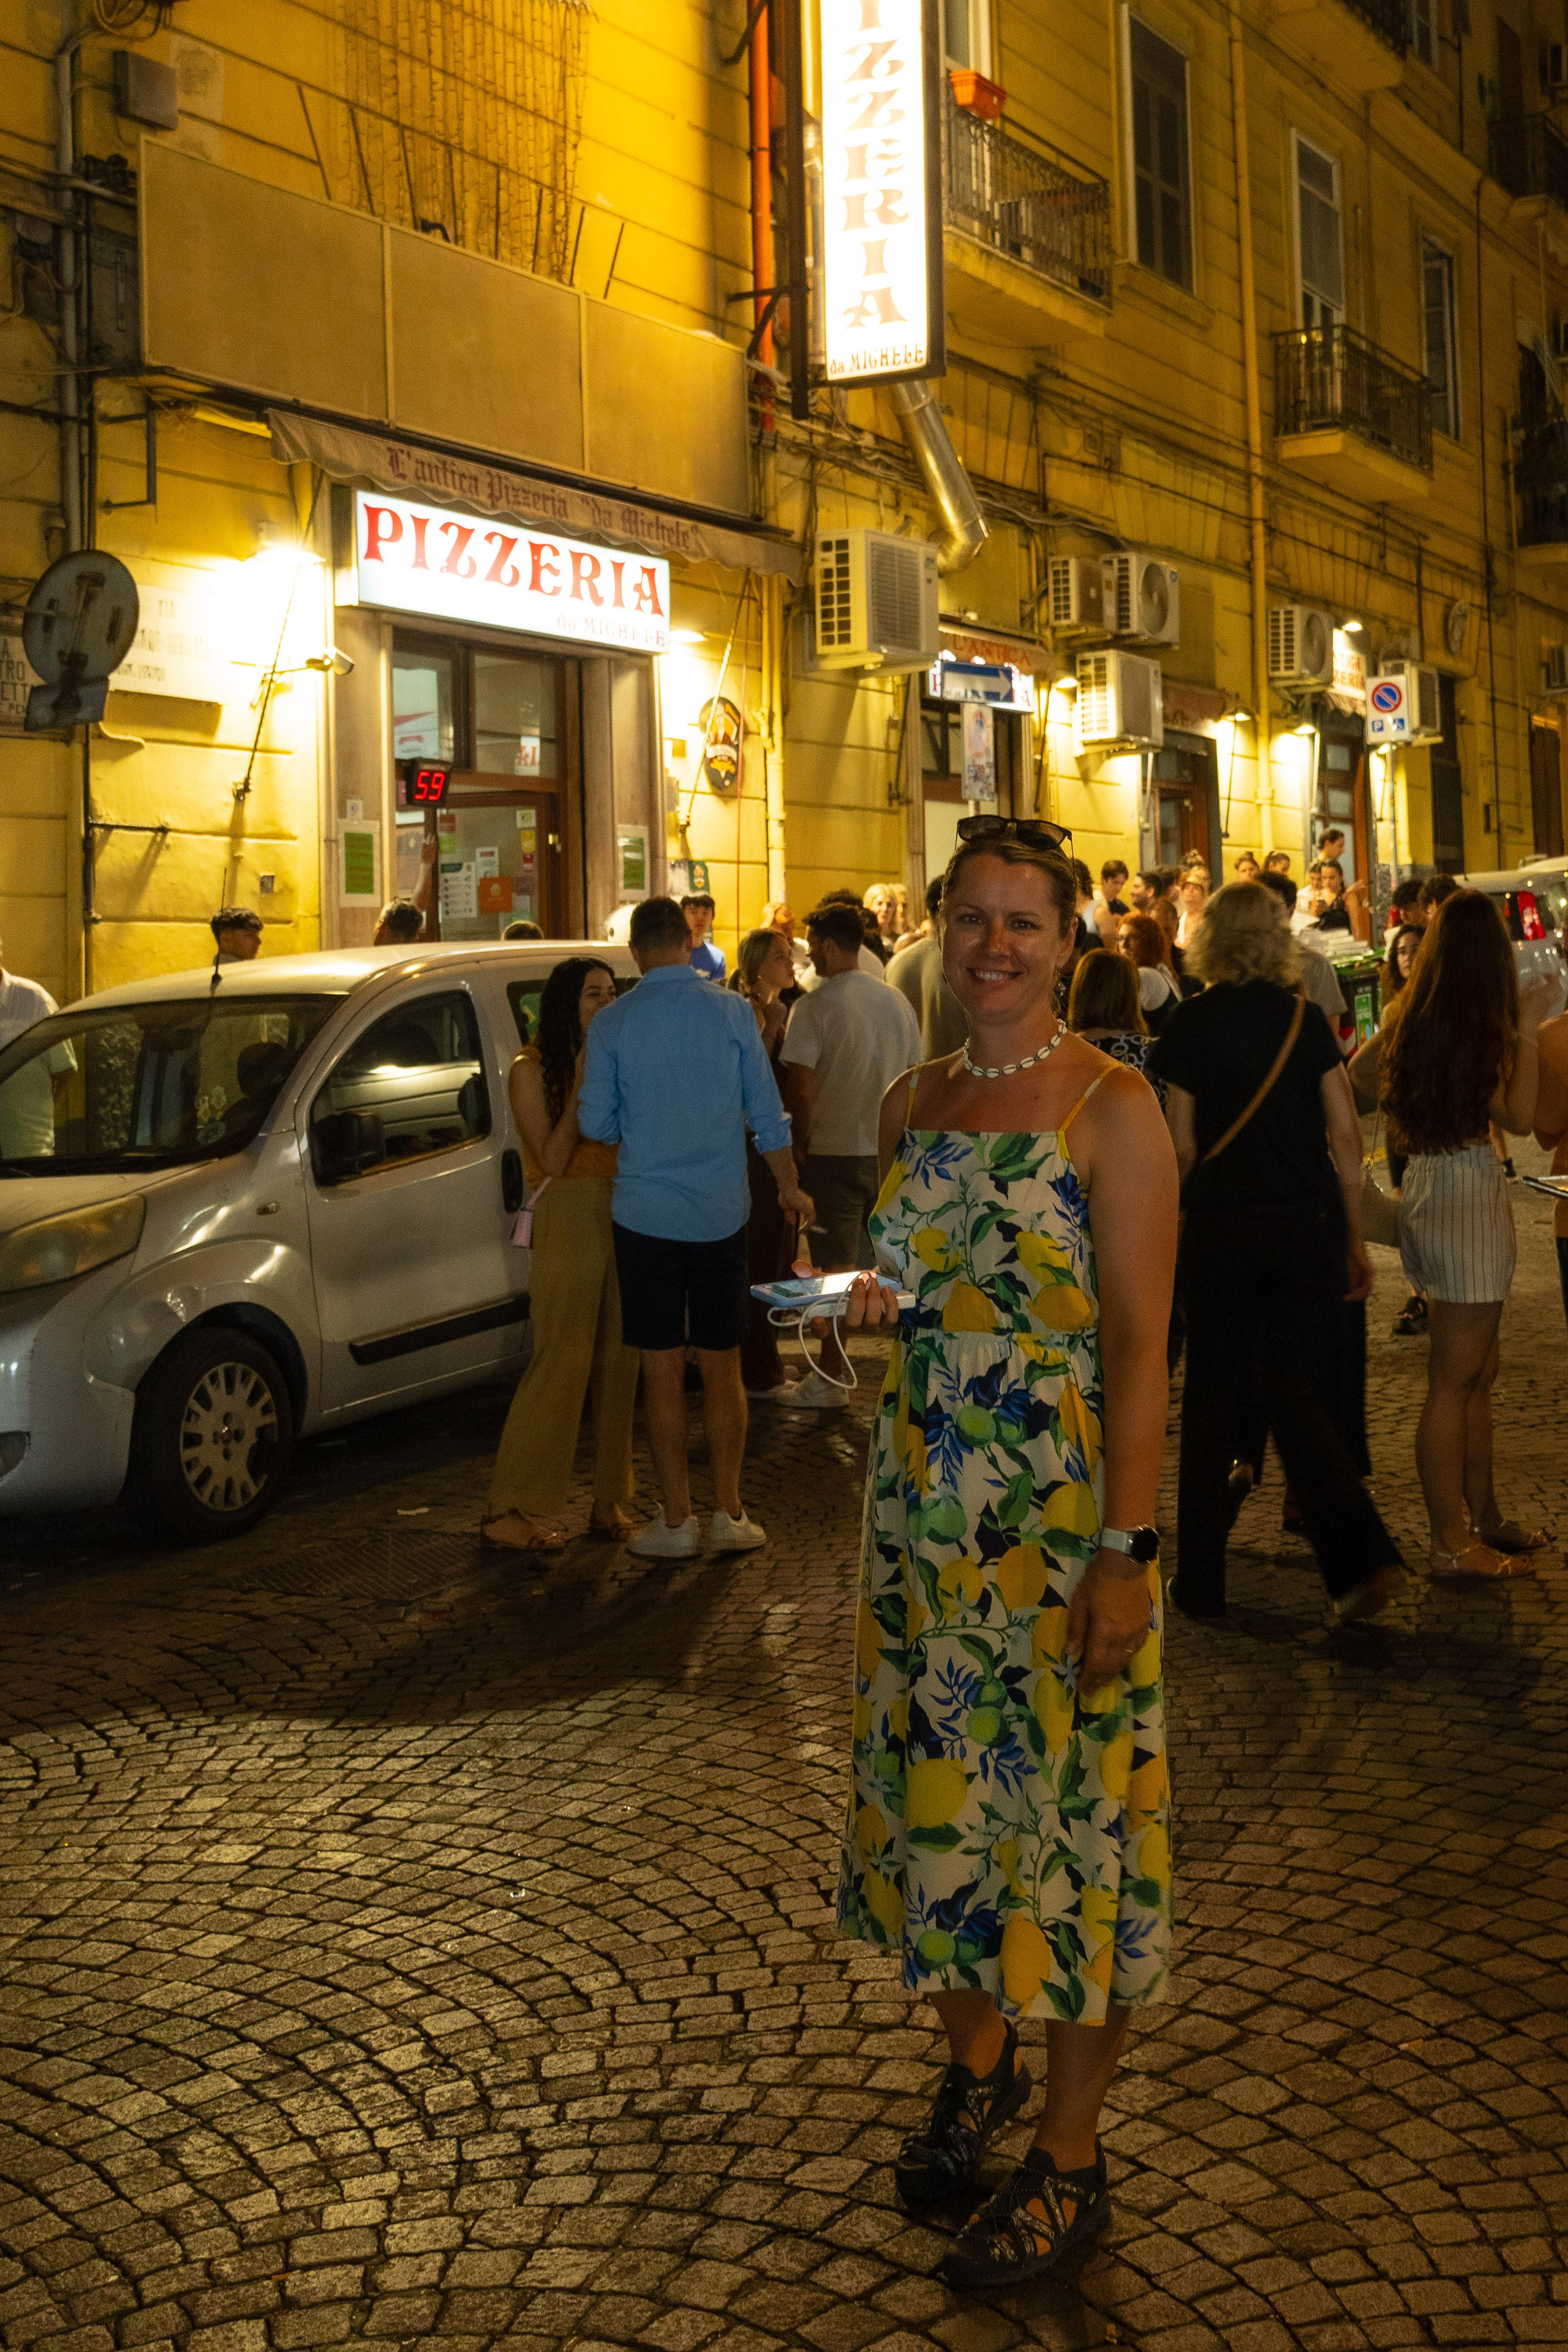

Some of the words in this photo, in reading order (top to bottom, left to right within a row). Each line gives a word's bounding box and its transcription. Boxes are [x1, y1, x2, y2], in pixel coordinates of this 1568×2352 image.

[842, 0, 908, 330] IZZERIA
[830, 359, 845, 374] da
[850, 344, 923, 372] MICHELE
[487, 470, 569, 518] Pizzeria
[363, 503, 665, 617] PIZZERIA
[414, 770, 445, 801] 59
